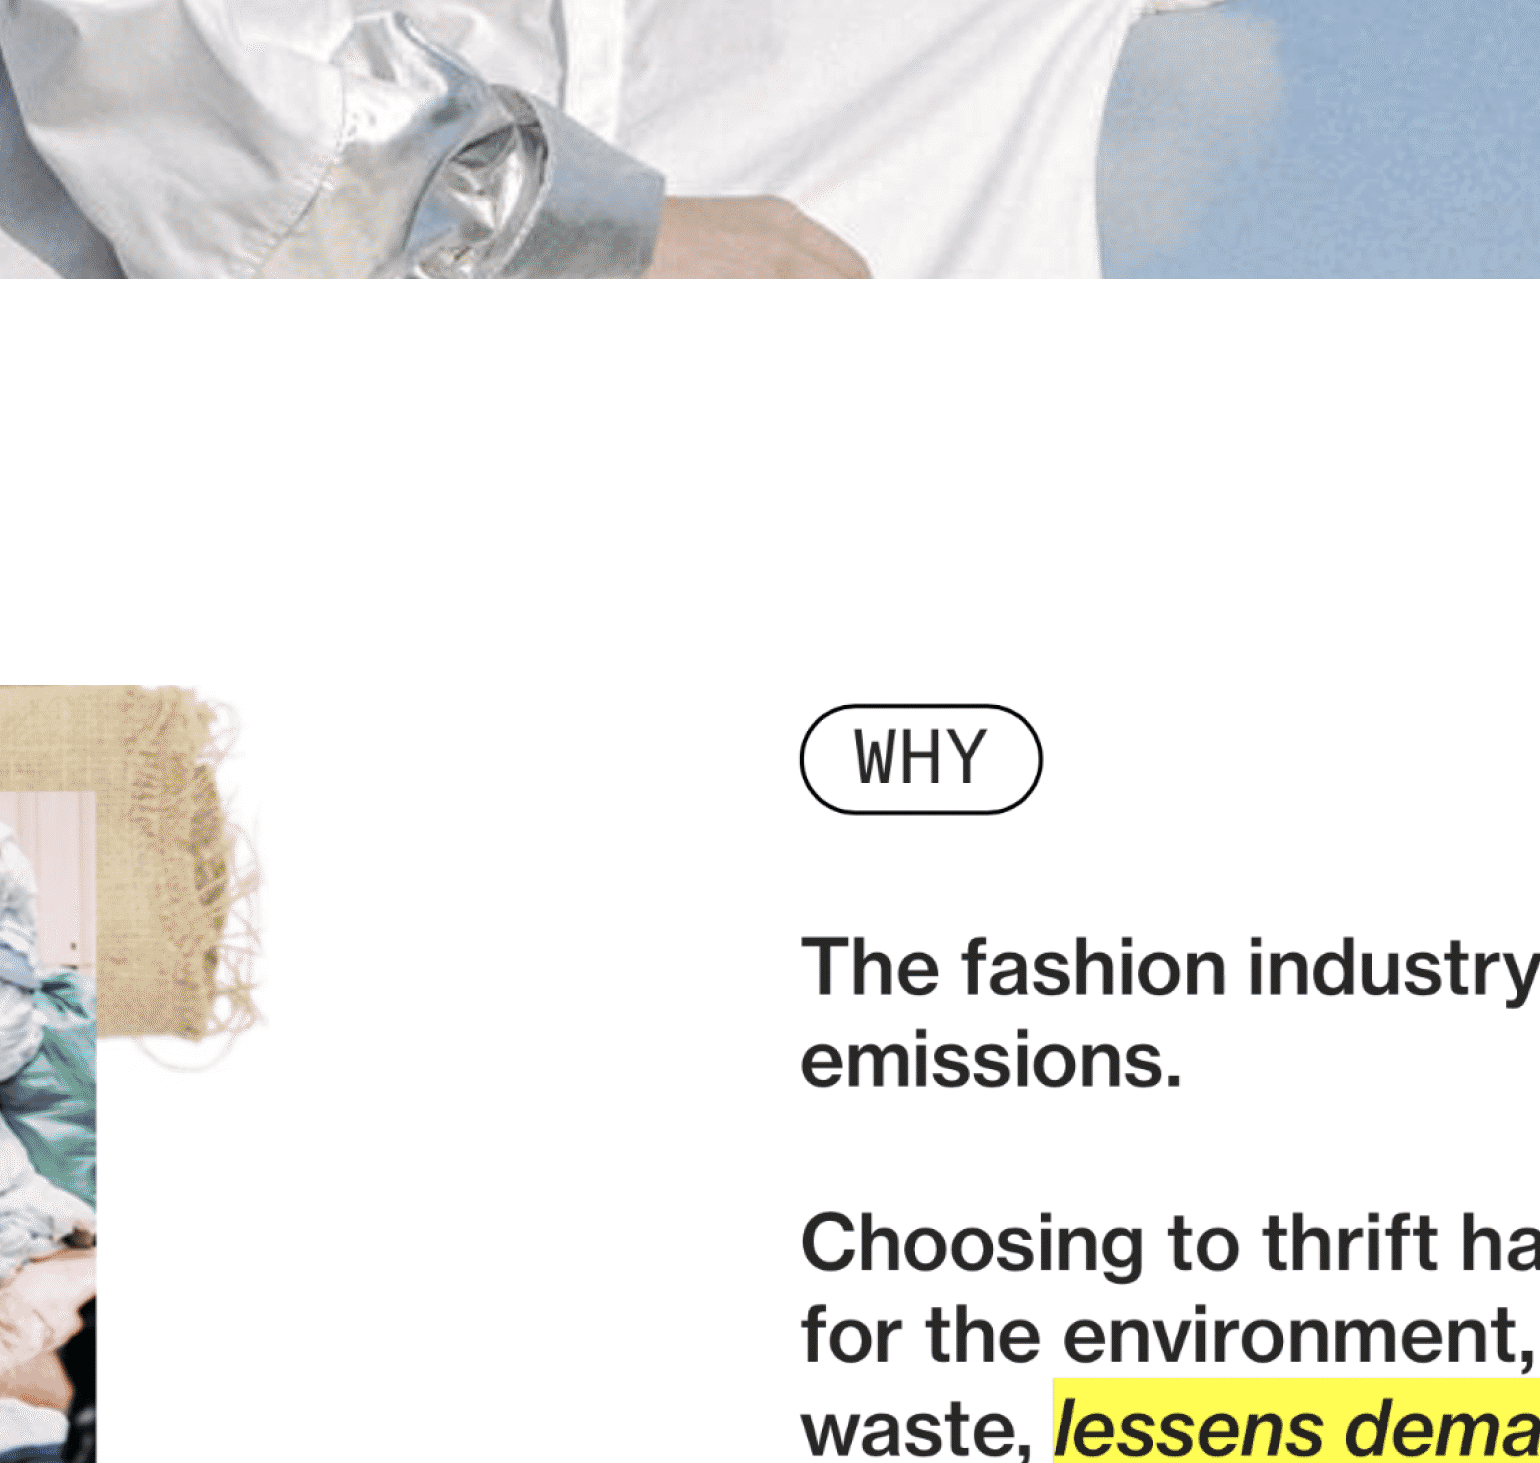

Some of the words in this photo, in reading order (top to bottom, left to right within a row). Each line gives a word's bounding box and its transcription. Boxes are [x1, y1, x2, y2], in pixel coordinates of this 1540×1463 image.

[854, 728, 988, 784] WHY
[801, 936, 939, 996] The
[961, 936, 1225, 996] fashion
[801, 1028, 1180, 1088] emissions.
[802, 1210, 1143, 1285] Choosing
[1167, 1215, 1240, 1272] to
[1262, 1212, 1438, 1271] thrift
[800, 1303, 903, 1364] for
[925, 1303, 1041, 1364] the
[1063, 1303, 1533, 1375] environment,
[1054, 1397, 1324, 1458] lessens
